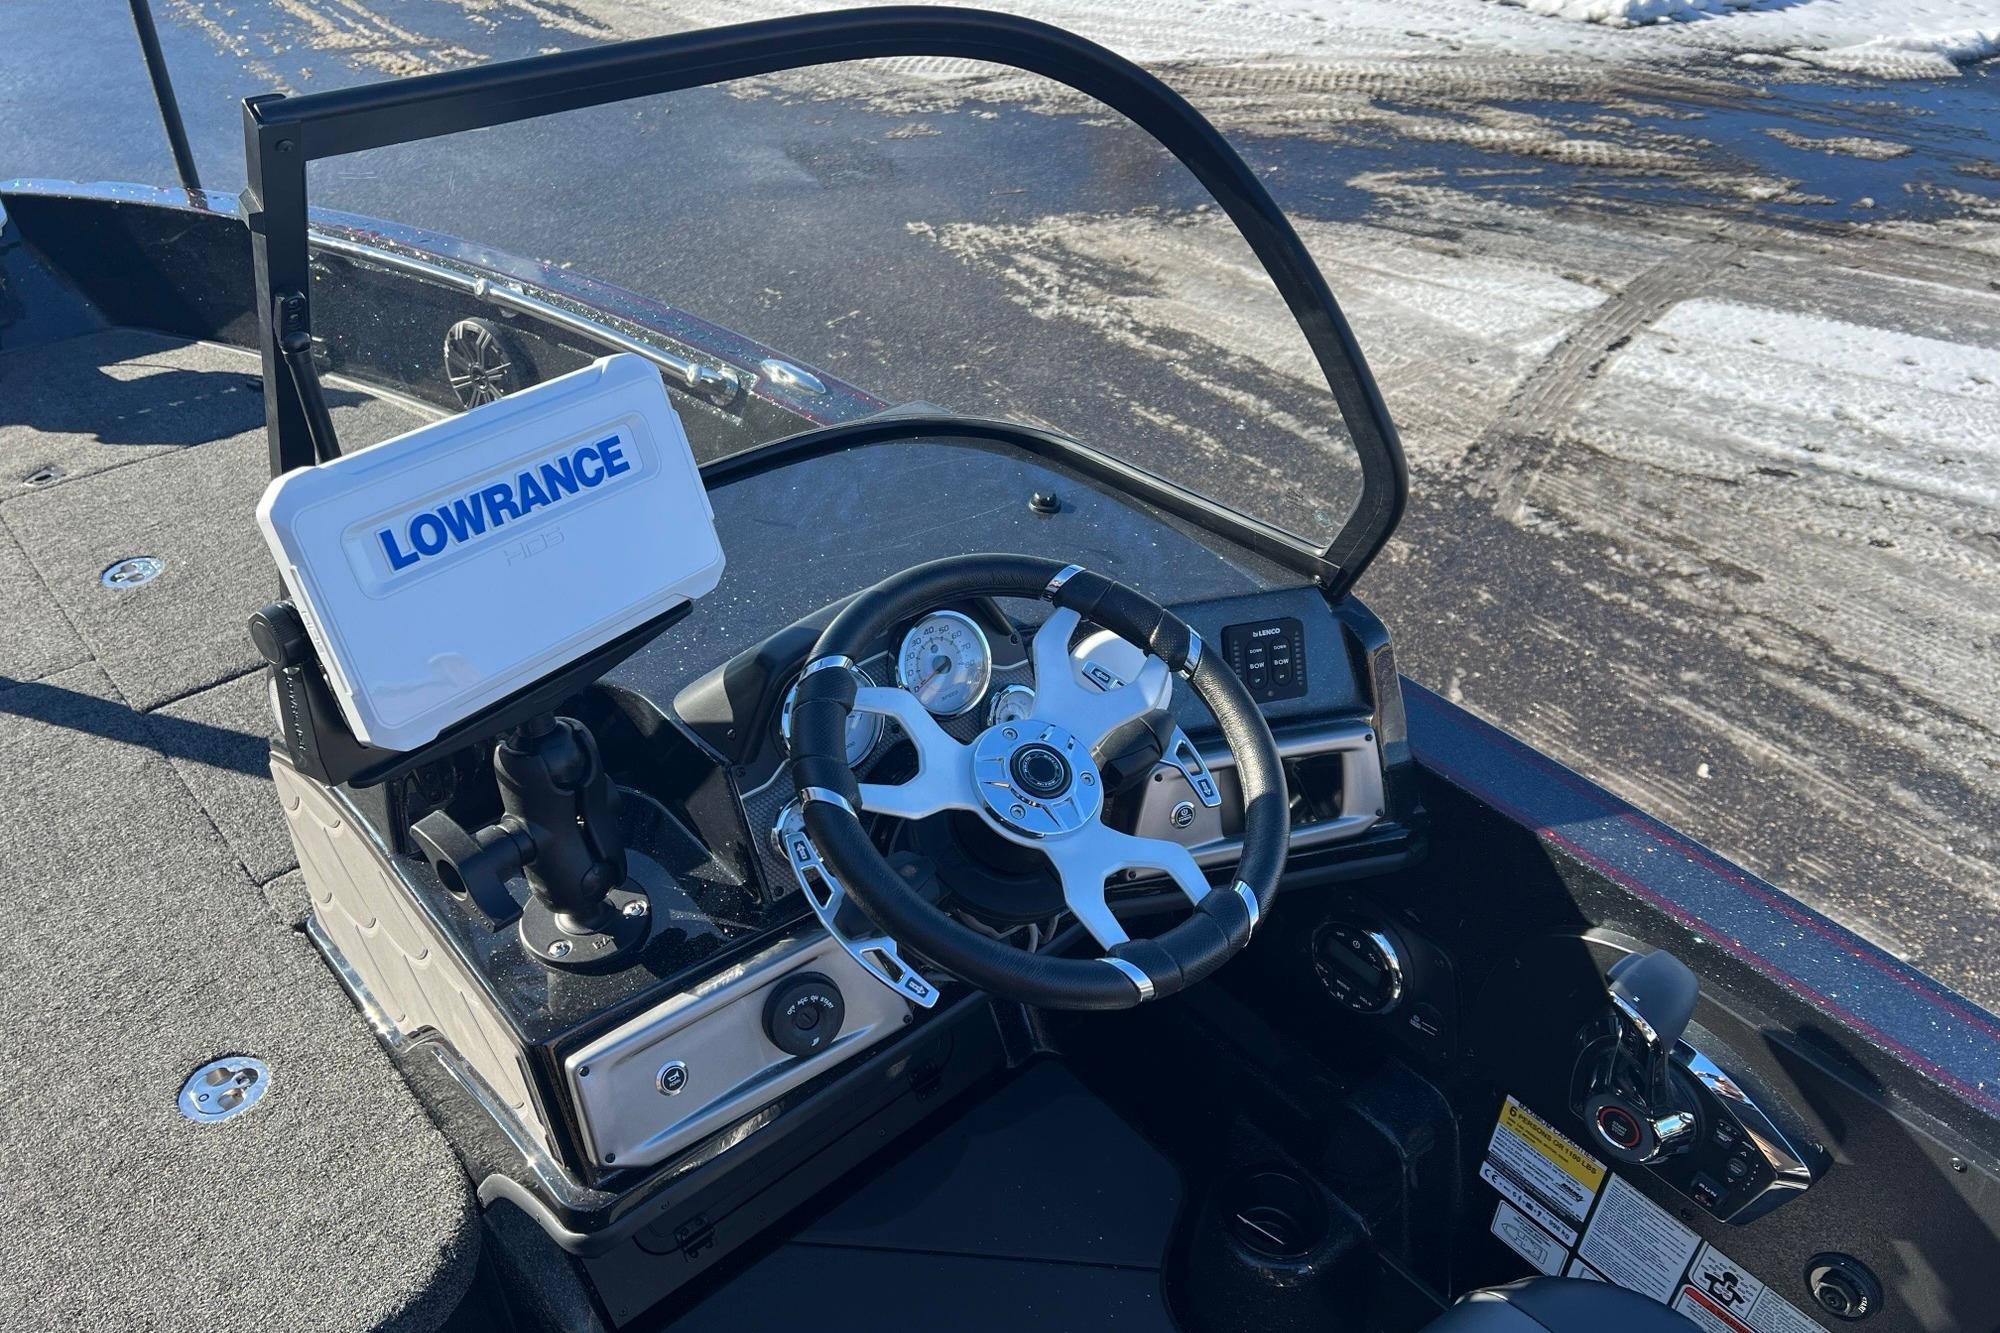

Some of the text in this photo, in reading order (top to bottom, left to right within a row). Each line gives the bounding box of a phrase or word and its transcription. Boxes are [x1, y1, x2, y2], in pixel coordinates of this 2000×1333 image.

[378, 435, 632, 572] LOWRANCE
[923, 626, 935, 636] 40
[951, 630, 962, 640] 60
[1258, 627, 1281, 637] LENCO
[911, 637, 922, 648] 30
[1249, 658, 1289, 670] BOW BOW
[820, 997, 834, 1009] START
[1509, 1106, 1598, 1175] 6 PERSONS OR 1100 LBS
